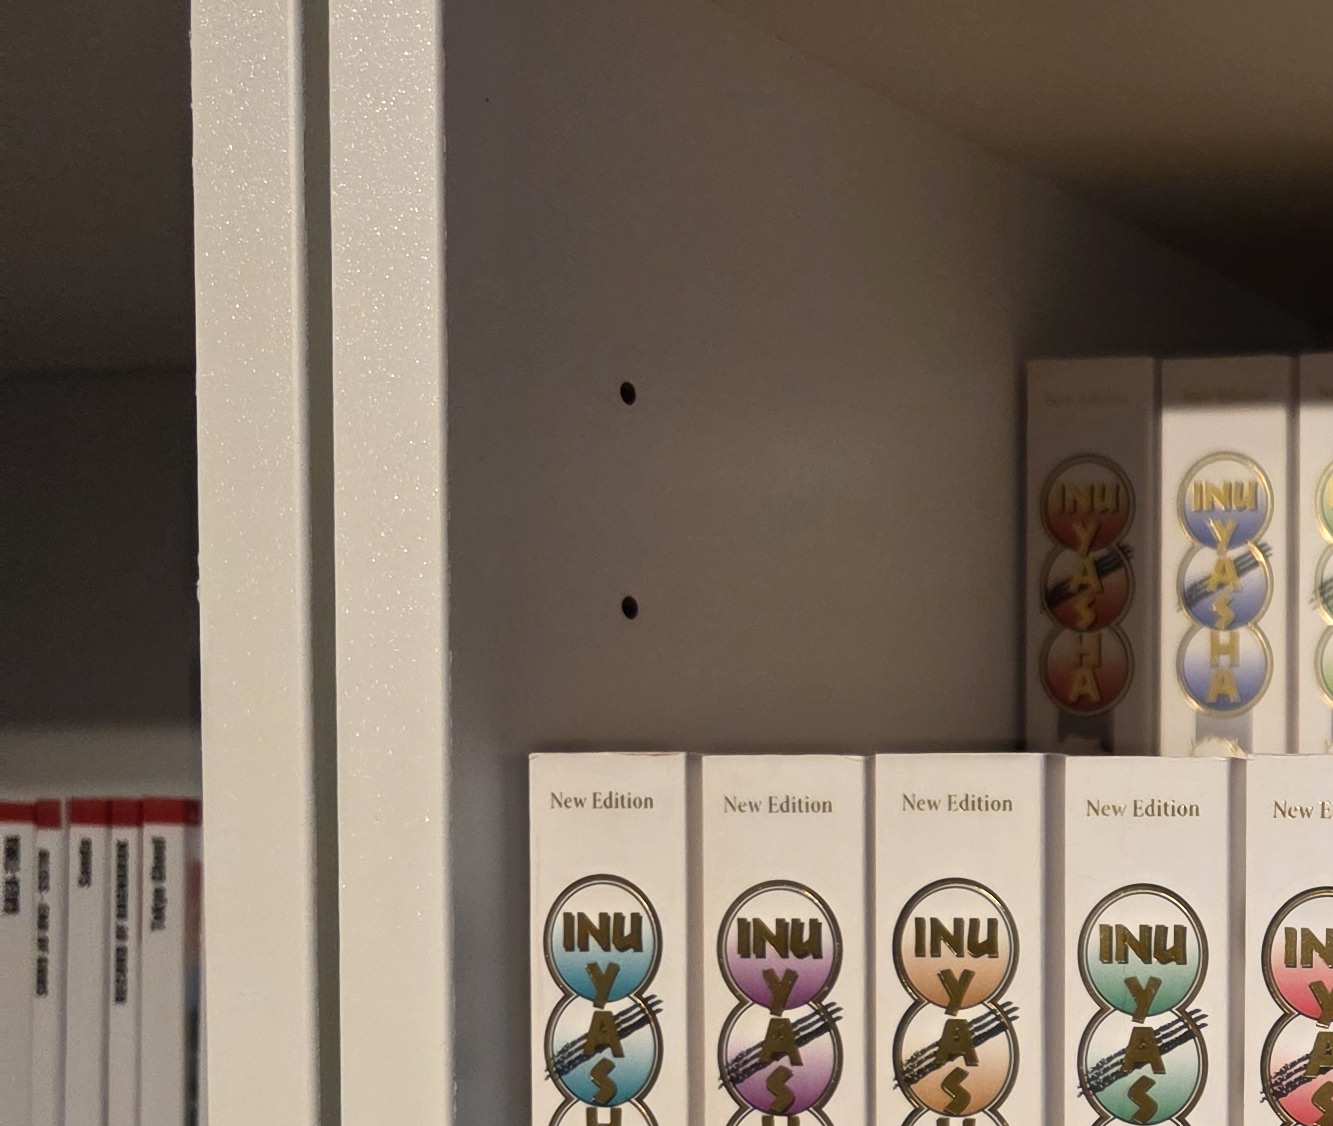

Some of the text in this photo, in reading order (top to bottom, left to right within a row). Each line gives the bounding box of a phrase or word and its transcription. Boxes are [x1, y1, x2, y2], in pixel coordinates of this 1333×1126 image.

[1193, 479, 1257, 512] INU
[551, 791, 653, 809] New Edition
[724, 795, 832, 813] New Edition
[903, 794, 1012, 811] New Edition
[1087, 799, 1199, 817] New Edition
[1274, 801, 1313, 818] New
[563, 911, 643, 953] INU
[737, 917, 823, 959] INU
[914, 916, 999, 959] INU
[1098, 923, 1187, 967] INU
